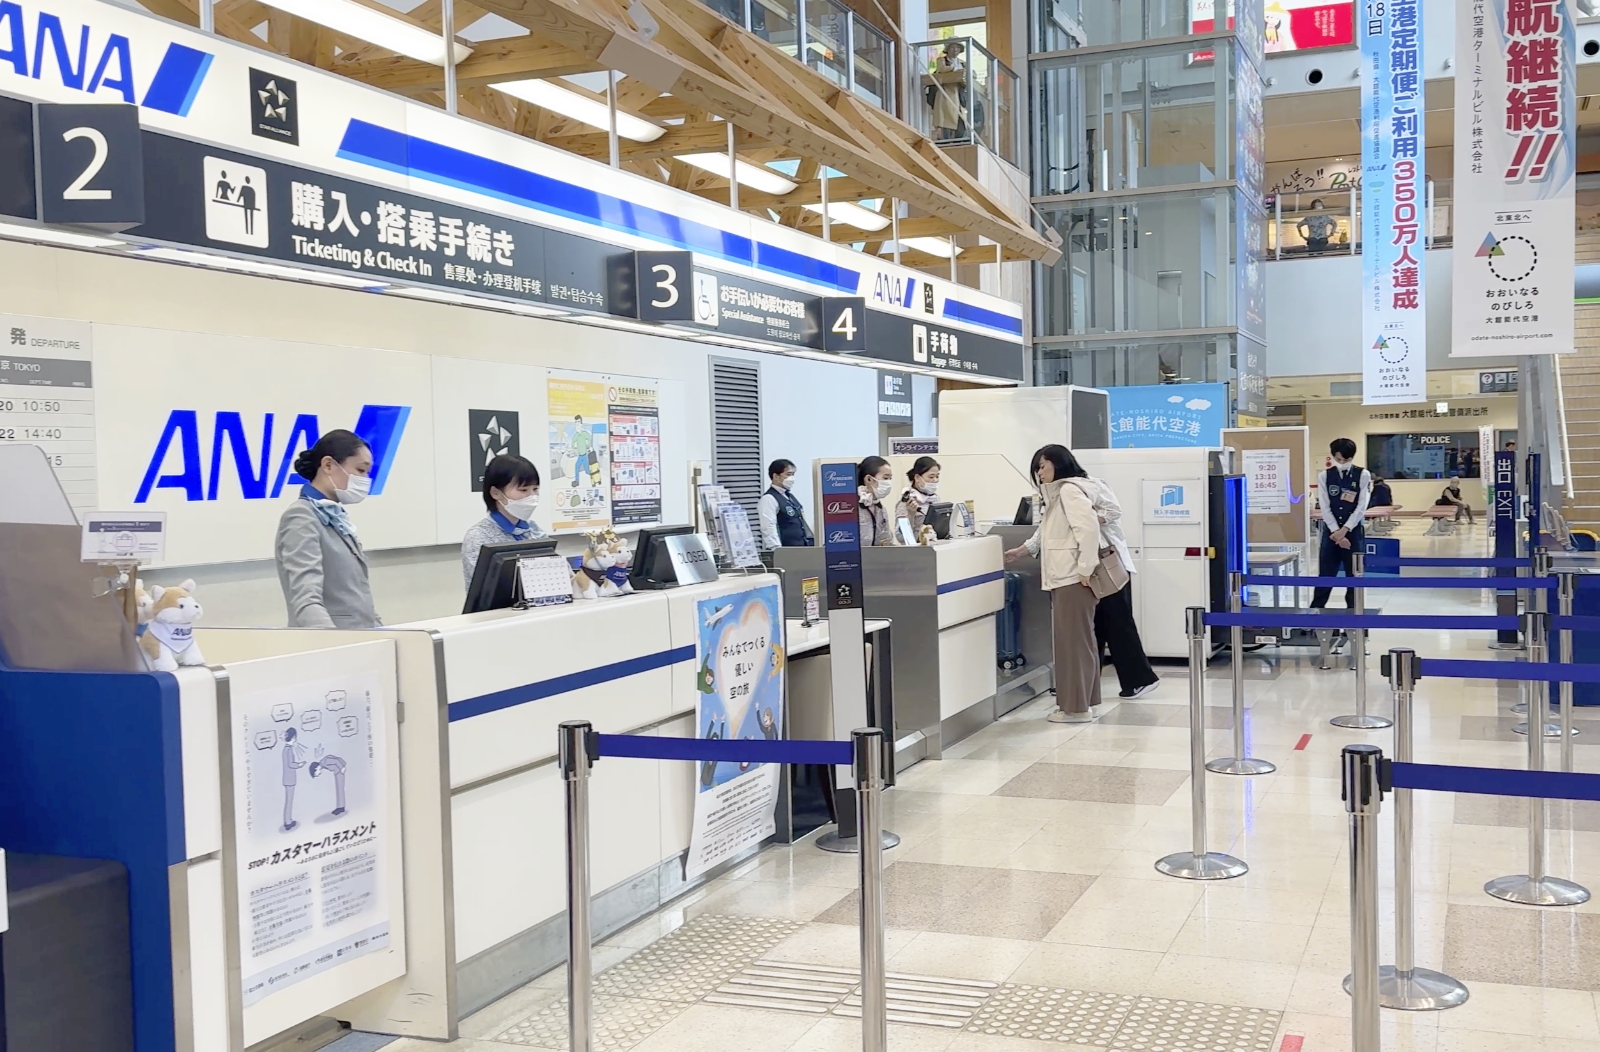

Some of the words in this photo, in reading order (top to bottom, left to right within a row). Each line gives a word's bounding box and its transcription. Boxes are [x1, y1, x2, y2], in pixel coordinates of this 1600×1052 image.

[1366, 0, 1386, 36] 18日
[0, 0, 136, 105] ANA
[1471, 0, 1484, 174] 代空港ターミナルビル株式会社
[62, 127, 112, 201] 2
[1391, 0, 1419, 310] 港定期便ご利用350万人達成
[292, 181, 515, 267] 購入・搭乗手続き
[1496, 213, 1531, 222] 北東北へ
[292, 236, 362, 270] Ticketing
[364, 245, 376, 267] &
[377, 251, 415, 275] Check
[420, 258, 433, 277] In
[651, 264, 679, 309] 3
[873, 272, 902, 307] ANA
[1486, 287, 1540, 298] おおいなる
[720, 284, 806, 319] お手伝いが必要なお客様
[1491, 300, 1534, 311] のびしろ
[721, 307, 740, 320] Special
[741, 309, 765, 324] Assistance
[832, 308, 857, 341] 4
[1485, 315, 1539, 325] 大館能代空港
[10, 327, 27, 346] 発
[31, 338, 81, 350] DEPARTURE
[930, 330, 958, 356] 手荷物
[1471, 332, 1553, 342] odate-noshiro-airport.com
[13, 362, 42, 372] TOKYO
[23, 401, 61, 412] 10:50
[24, 428, 62, 440] 14:40
[1420, 436, 1451, 445] POLICE
[133, 409, 322, 503] ANA
[825, 470, 853, 483] Premium
[1255, 473, 1277, 481] 13:10
[1258, 464, 1277, 472] 9:20
[1497, 458, 1512, 484] 出口
[832, 480, 847, 488] class
[1255, 482, 1277, 490] 16:45
[1497, 490, 1513, 519] EXIT
[677, 549, 709, 565] CLOSED
[722, 636, 765, 658] みんなでつくる
[735, 662, 754, 678] 優しい
[730, 682, 750, 700] 空の旅
[248, 857, 270, 871] STOP!
[270, 820, 378, 866] カスタマーハラスメント
